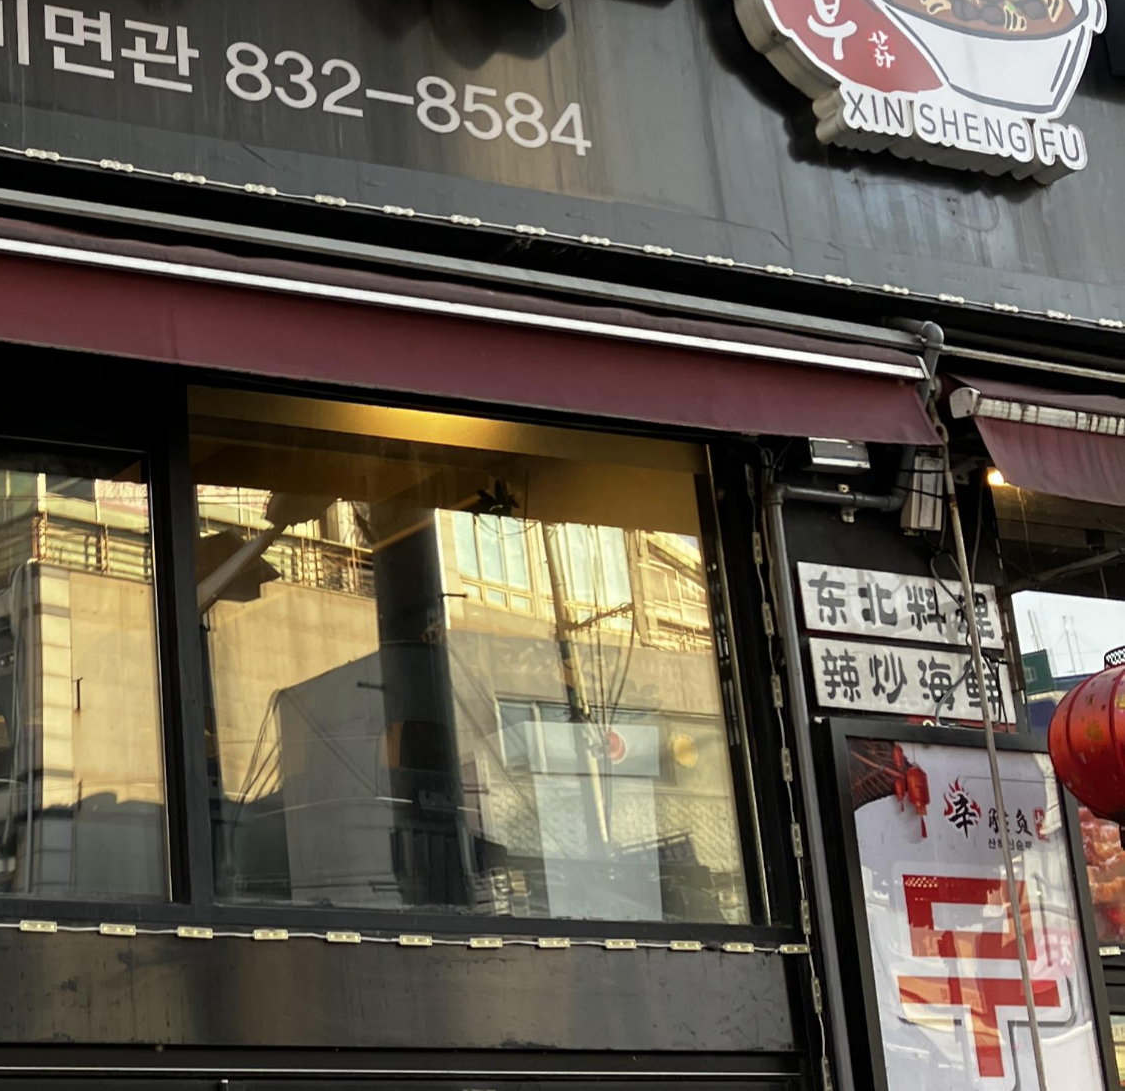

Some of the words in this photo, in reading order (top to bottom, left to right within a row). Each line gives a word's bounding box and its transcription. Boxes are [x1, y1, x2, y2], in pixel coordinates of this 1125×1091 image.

[225, 41, 593, 157] 832-8584
[844, 91, 906, 129] XIN
[920, 102, 1028, 155] SHENG
[1037, 127, 1082, 162] FU
[808, 571, 995, 640] 东北料理
[820, 648, 1002, 716] 辣炒海鲜
